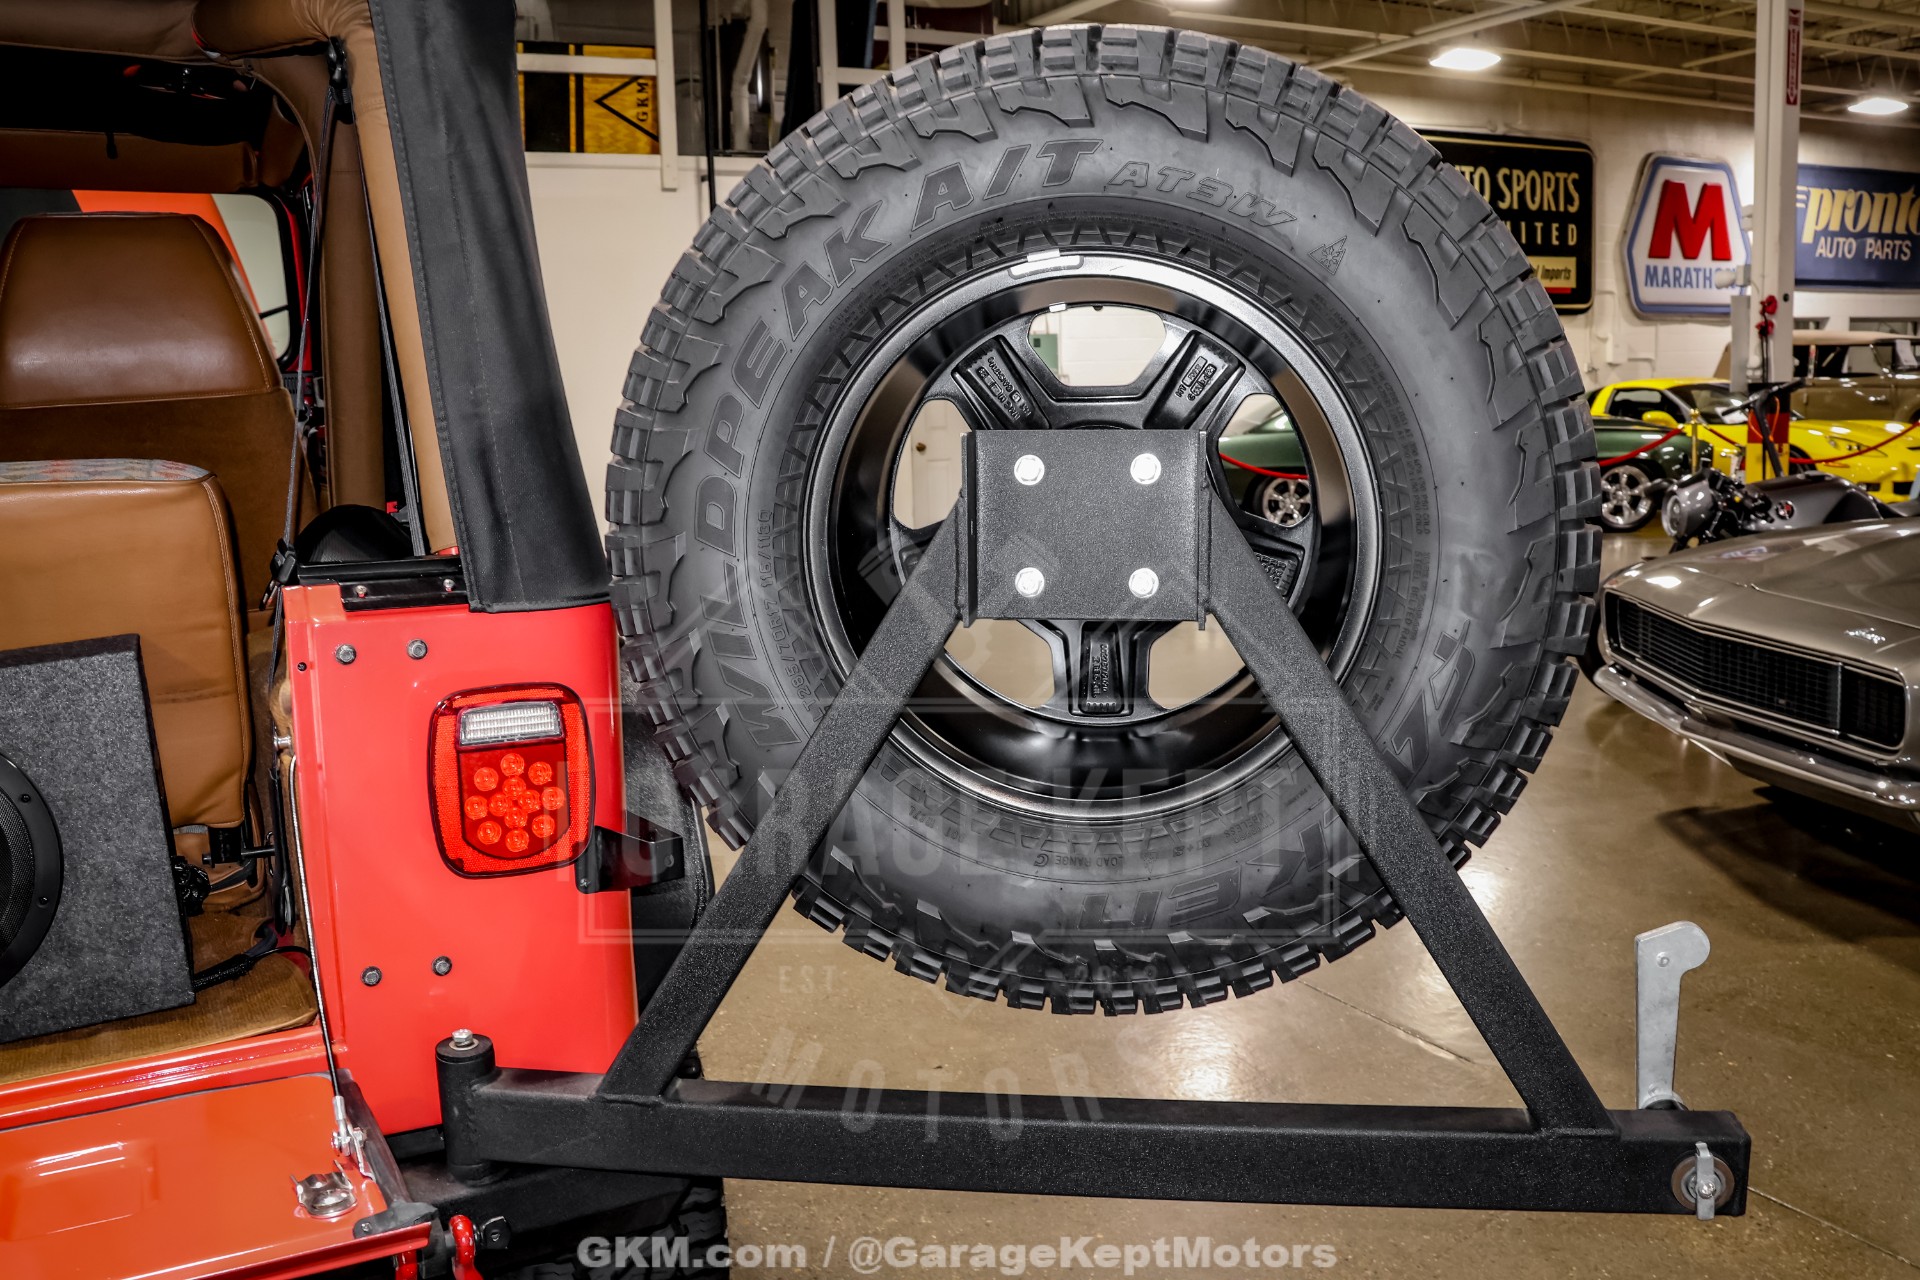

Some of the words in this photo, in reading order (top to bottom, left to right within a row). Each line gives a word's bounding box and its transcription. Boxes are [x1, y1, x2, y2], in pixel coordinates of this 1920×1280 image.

[636, 81, 649, 122] GKM
[1496, 167, 1580, 213] SPORTS
[1648, 179, 1732, 261] M
[1815, 236, 1857, 260] AUTO
[1864, 238, 1912, 261] PARTS
[1644, 264, 1736, 289] MARATH
[695, 199, 890, 748] WILDPEAK
[1109, 163, 1297, 227] AT3W
[1391, 626, 1412, 661] RADIAL
[1078, 619, 1479, 930] FAKEN
[1055, 854, 1092, 867] RANGE
